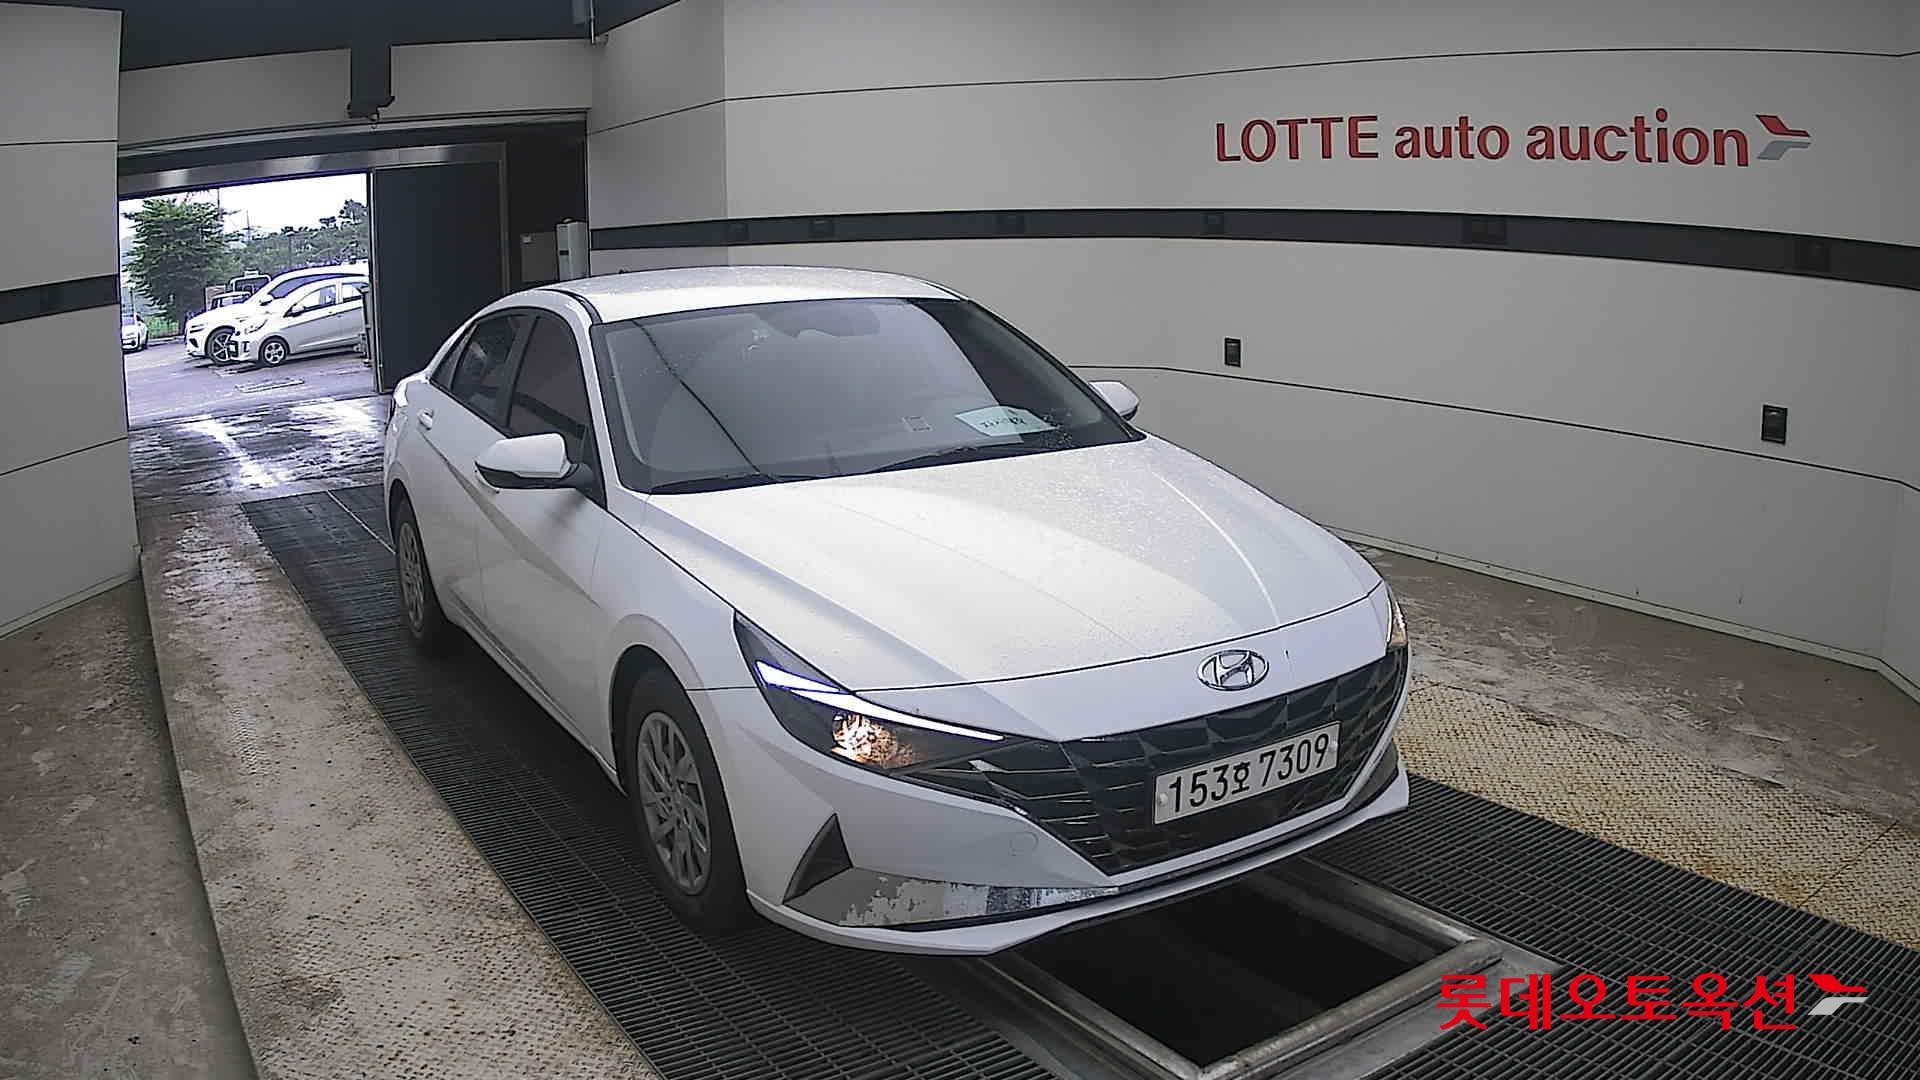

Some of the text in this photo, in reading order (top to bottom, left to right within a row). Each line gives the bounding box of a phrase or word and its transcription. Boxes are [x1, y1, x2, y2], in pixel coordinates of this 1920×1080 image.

[1215, 108, 1749, 167] LOTTE auto auction
[1259, 733, 1330, 787] 7309
